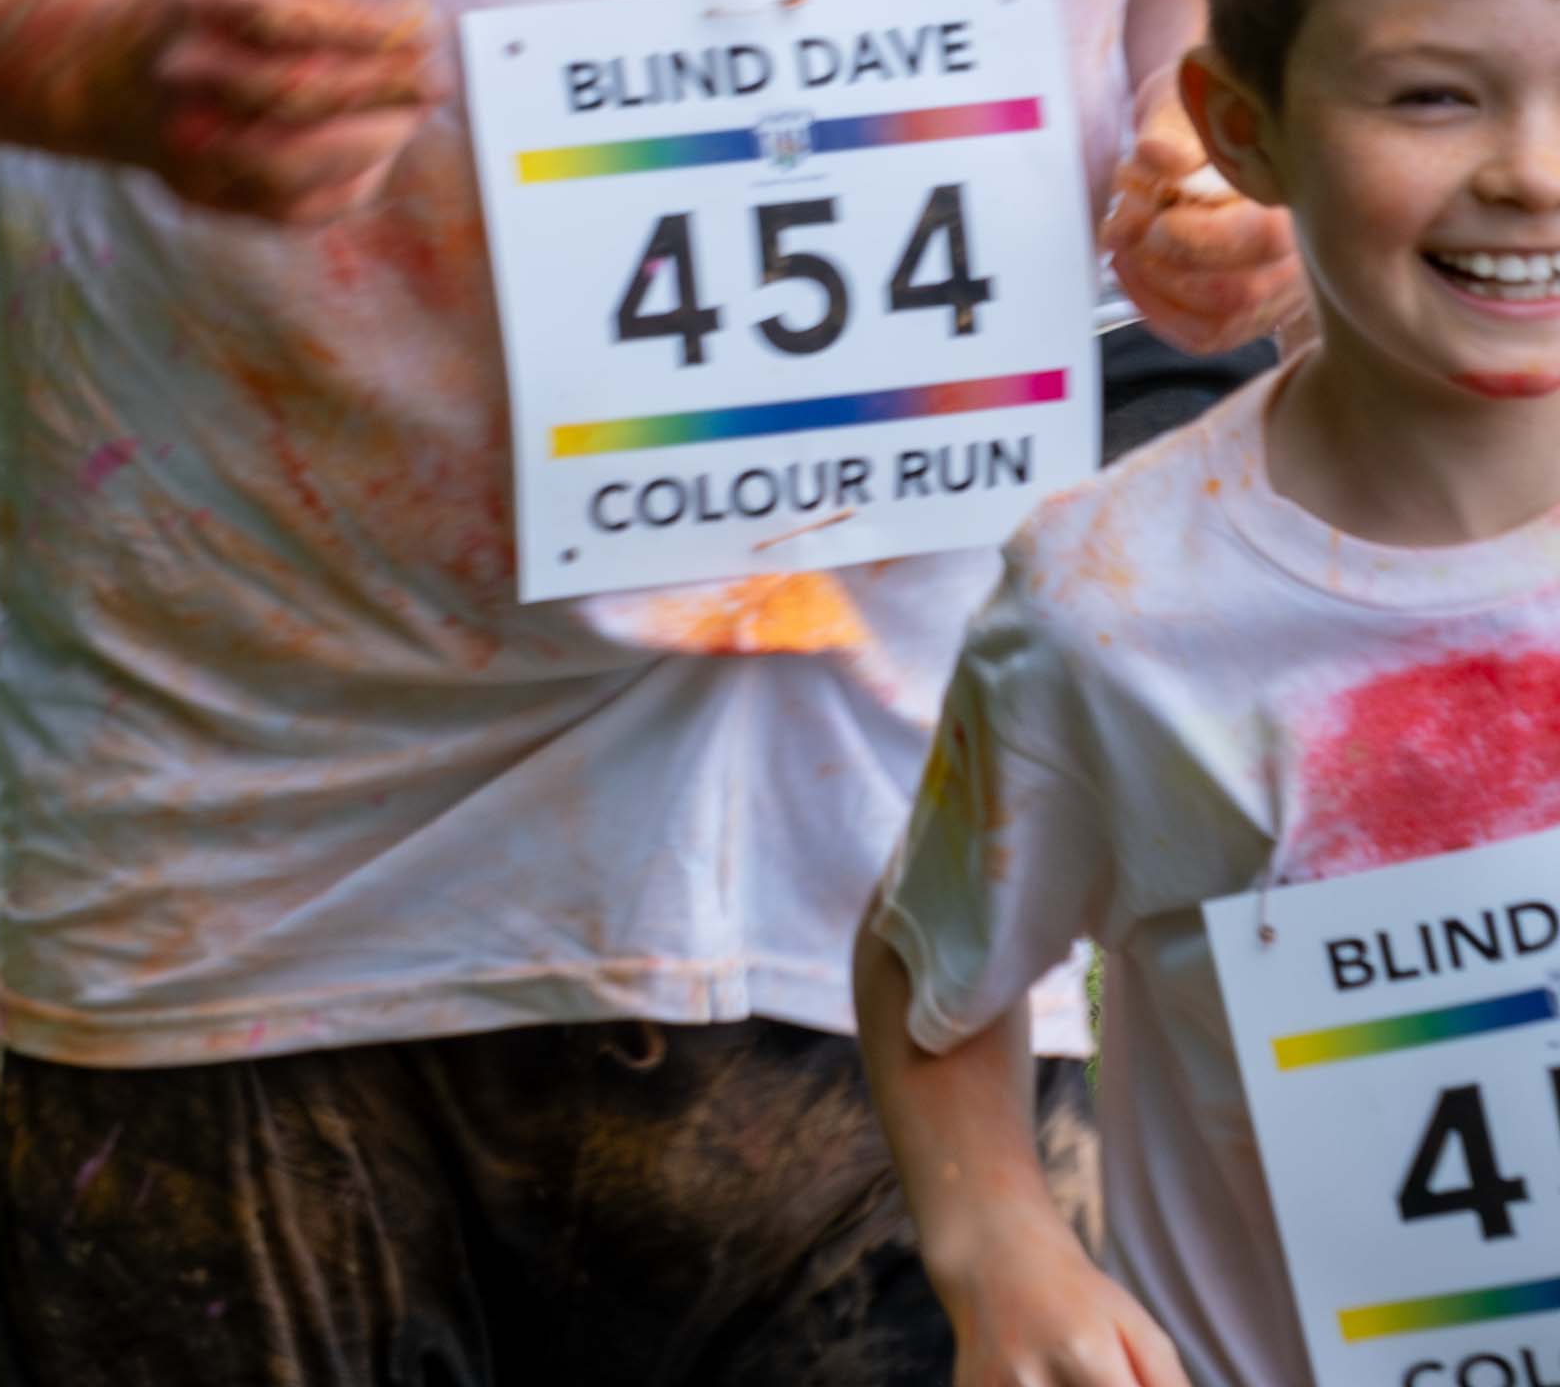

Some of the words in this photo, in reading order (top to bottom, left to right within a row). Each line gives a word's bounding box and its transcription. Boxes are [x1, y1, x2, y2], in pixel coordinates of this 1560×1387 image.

[564, 44, 774, 114] BLIND
[795, 21, 978, 89] DAVE
[612, 182, 997, 368] 454
[589, 455, 873, 533] COLOUR
[893, 435, 1035, 498] RUN
[1325, 901, 1560, 991] BLIND
[1395, 1069, 1560, 1242] 4
